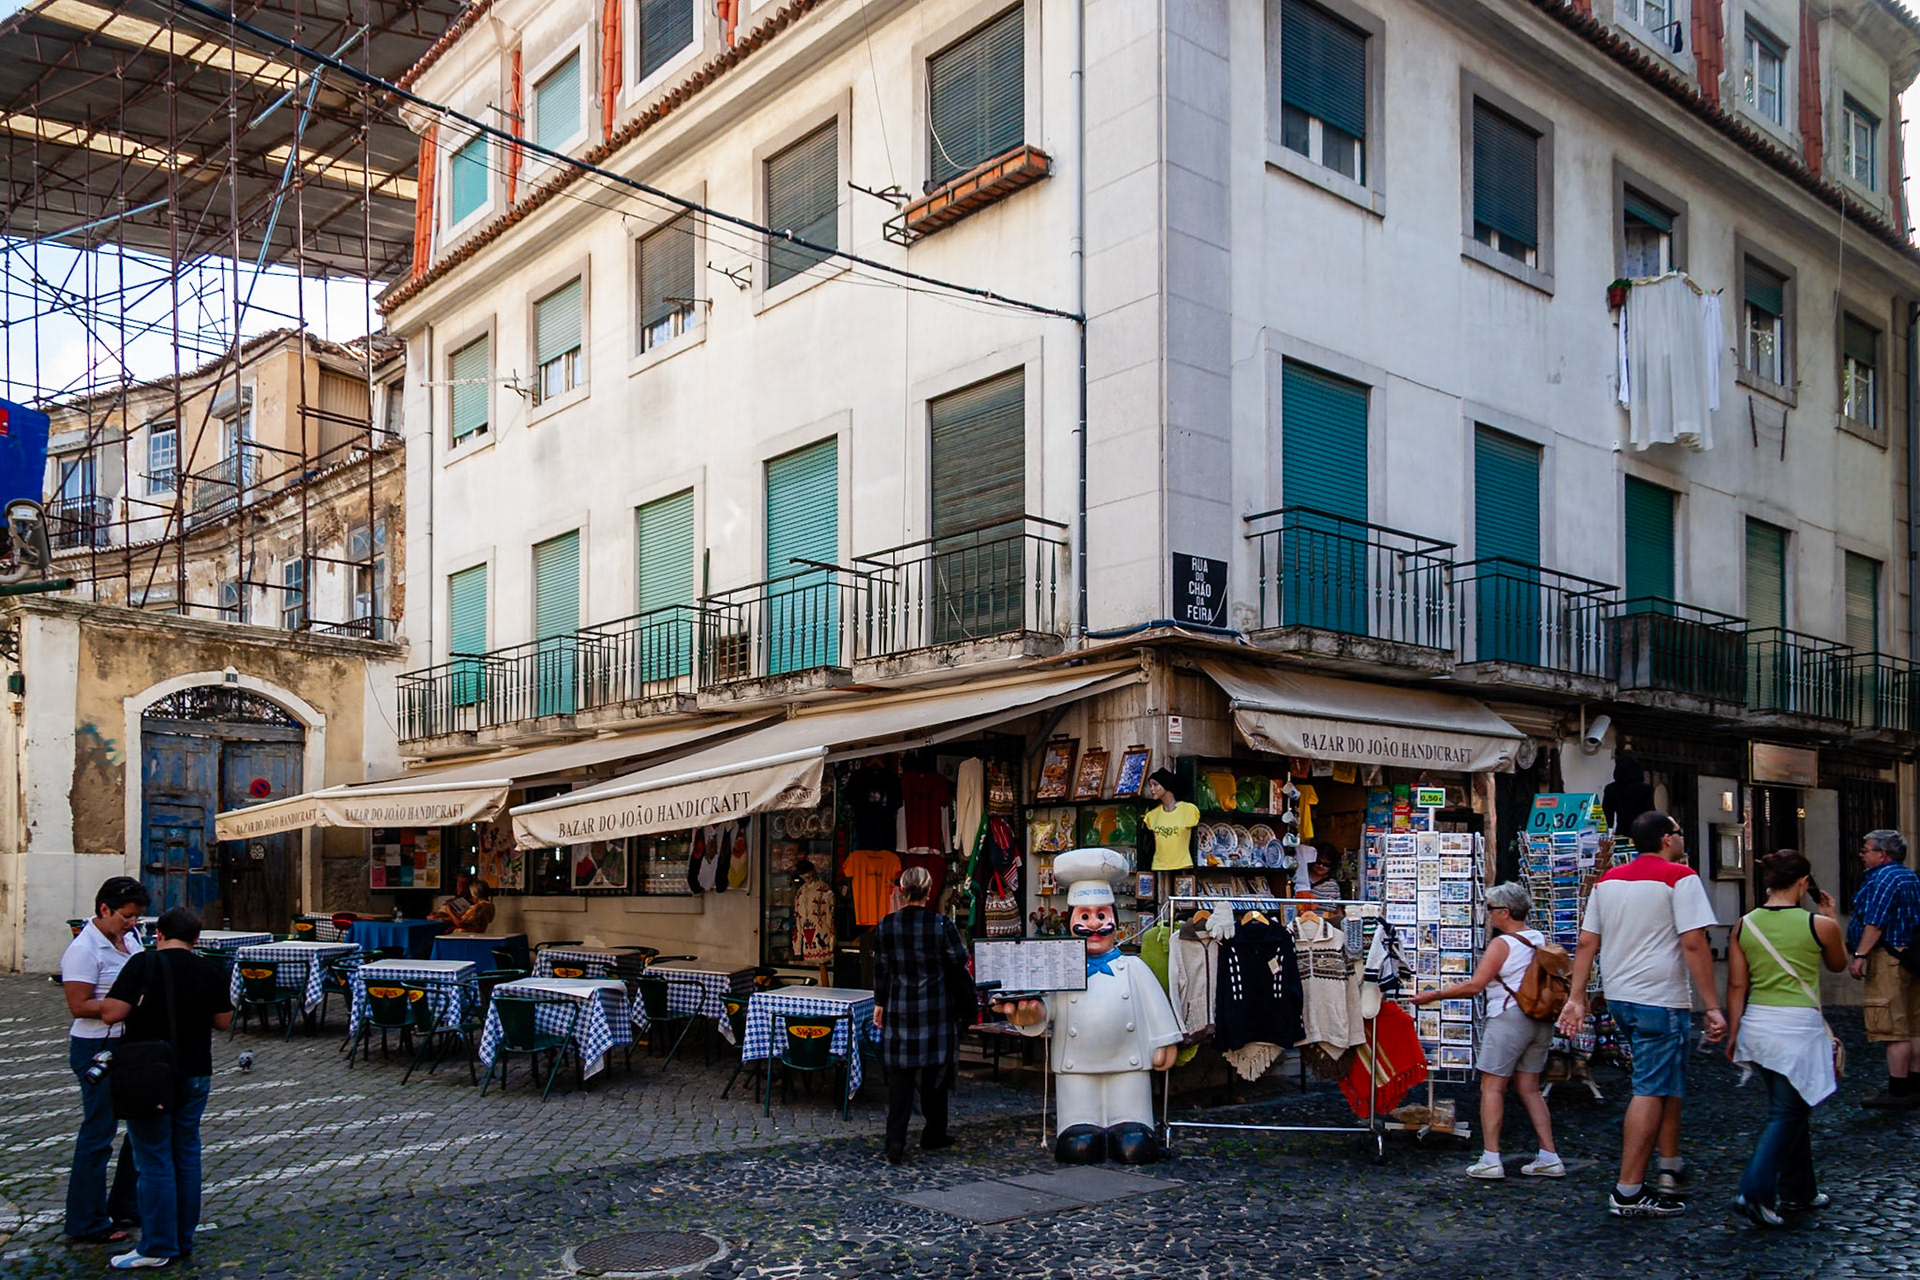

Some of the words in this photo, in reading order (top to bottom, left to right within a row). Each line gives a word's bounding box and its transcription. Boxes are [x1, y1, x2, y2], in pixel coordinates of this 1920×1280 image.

[1191, 557, 1208, 573] RUA
[1195, 572, 1204, 582] DO
[1188, 580, 1211, 598] CHÃO
[1195, 596, 1205, 605] DA
[1187, 605, 1213, 622] FEIRA
[1302, 733, 1344, 752] BAZAR
[1347, 737, 1364, 754] DO
[1367, 736, 1399, 758] JOÃO
[1401, 742, 1472, 764] HANDICRAFT
[345, 808, 370, 821] BAZAR
[370, 808, 383, 821] DO
[384, 804, 406, 821] JOÃO
[407, 803, 465, 820] HANDICRAFT
[558, 817, 595, 839] BAZAR
[599, 814, 617, 832] DO
[619, 805, 653, 829] JOÃO
[657, 791, 750, 823] HANDICRAFT
[236, 821, 255, 834] BAZAR
[255, 820, 263, 831] DO
[280, 809, 317, 826] HANDICRAFT
[1534, 812, 1577, 832] 0,30
